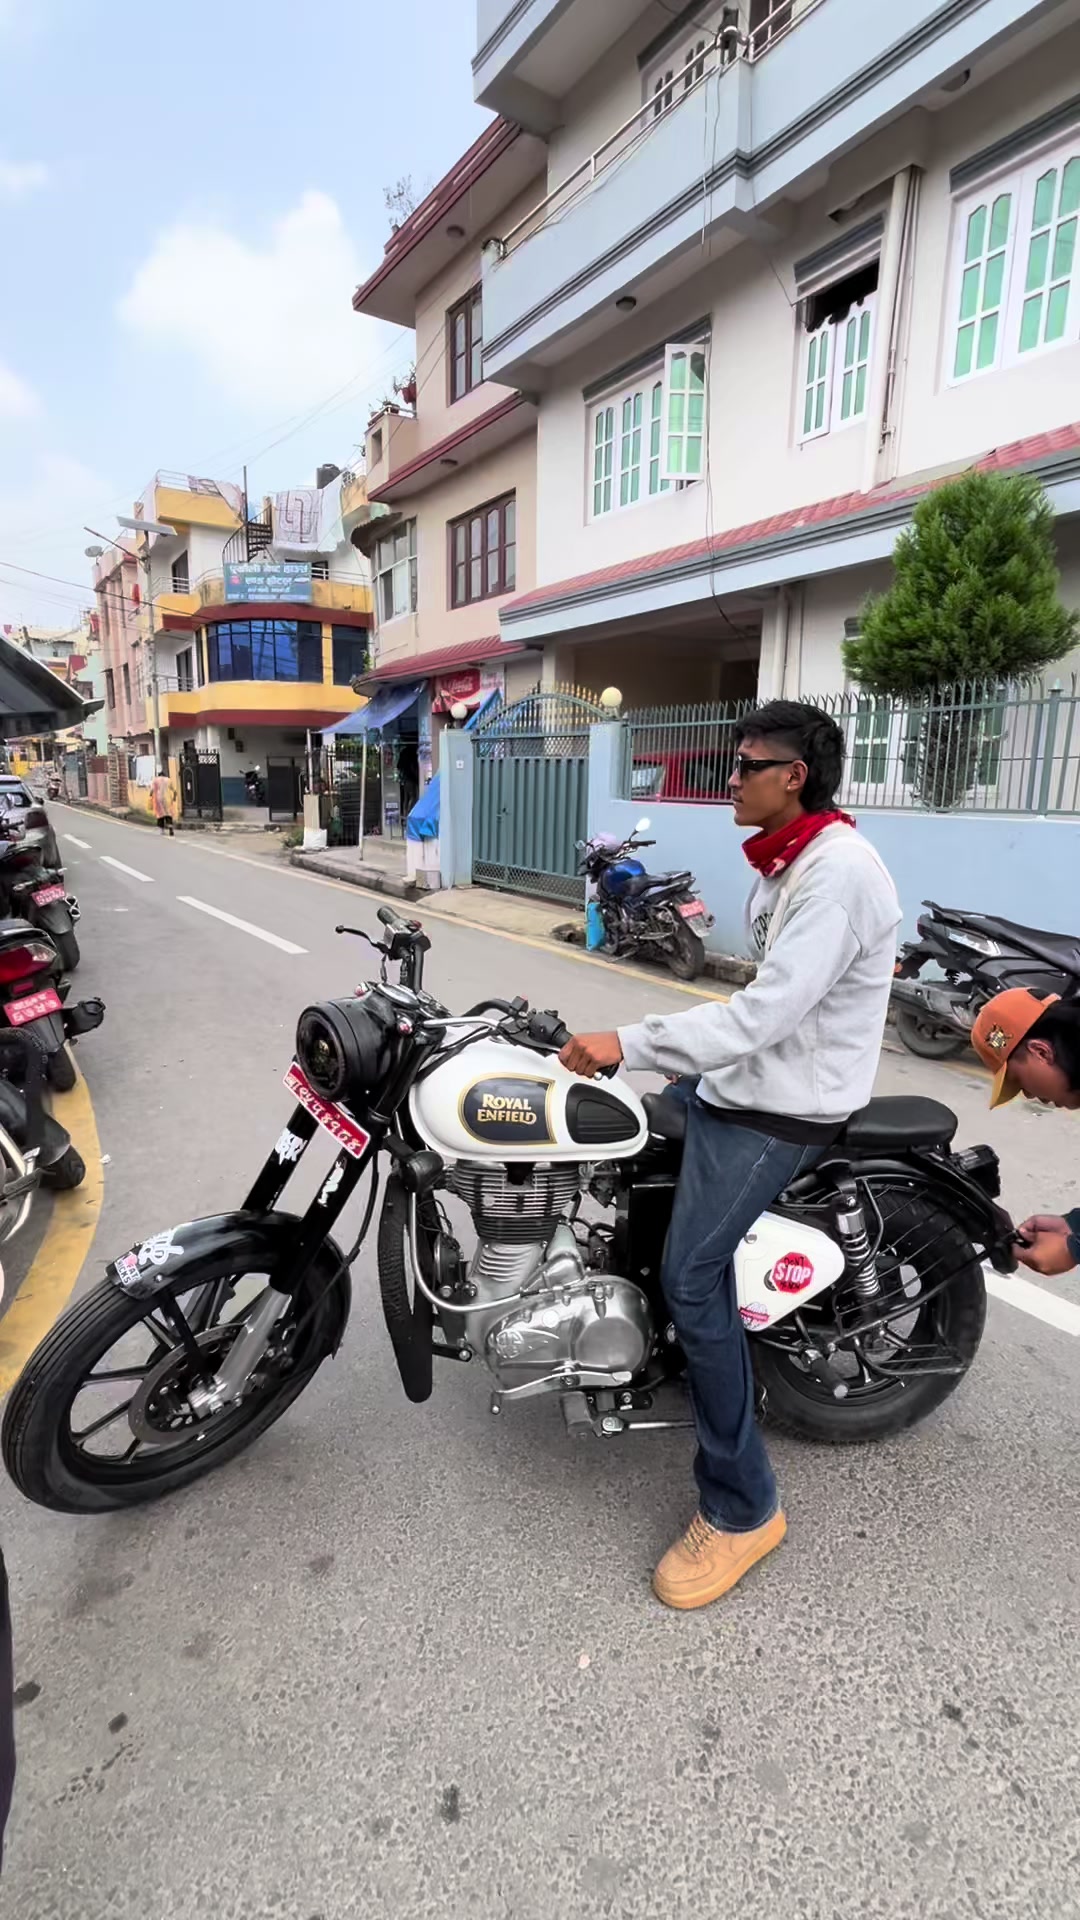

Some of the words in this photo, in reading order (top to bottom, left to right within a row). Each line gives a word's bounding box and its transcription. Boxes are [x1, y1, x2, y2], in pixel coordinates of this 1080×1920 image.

[482, 1093, 532, 1110] ROYAL
[477, 1108, 537, 1125] ENFIELD
[775, 1262, 811, 1284] STOP
